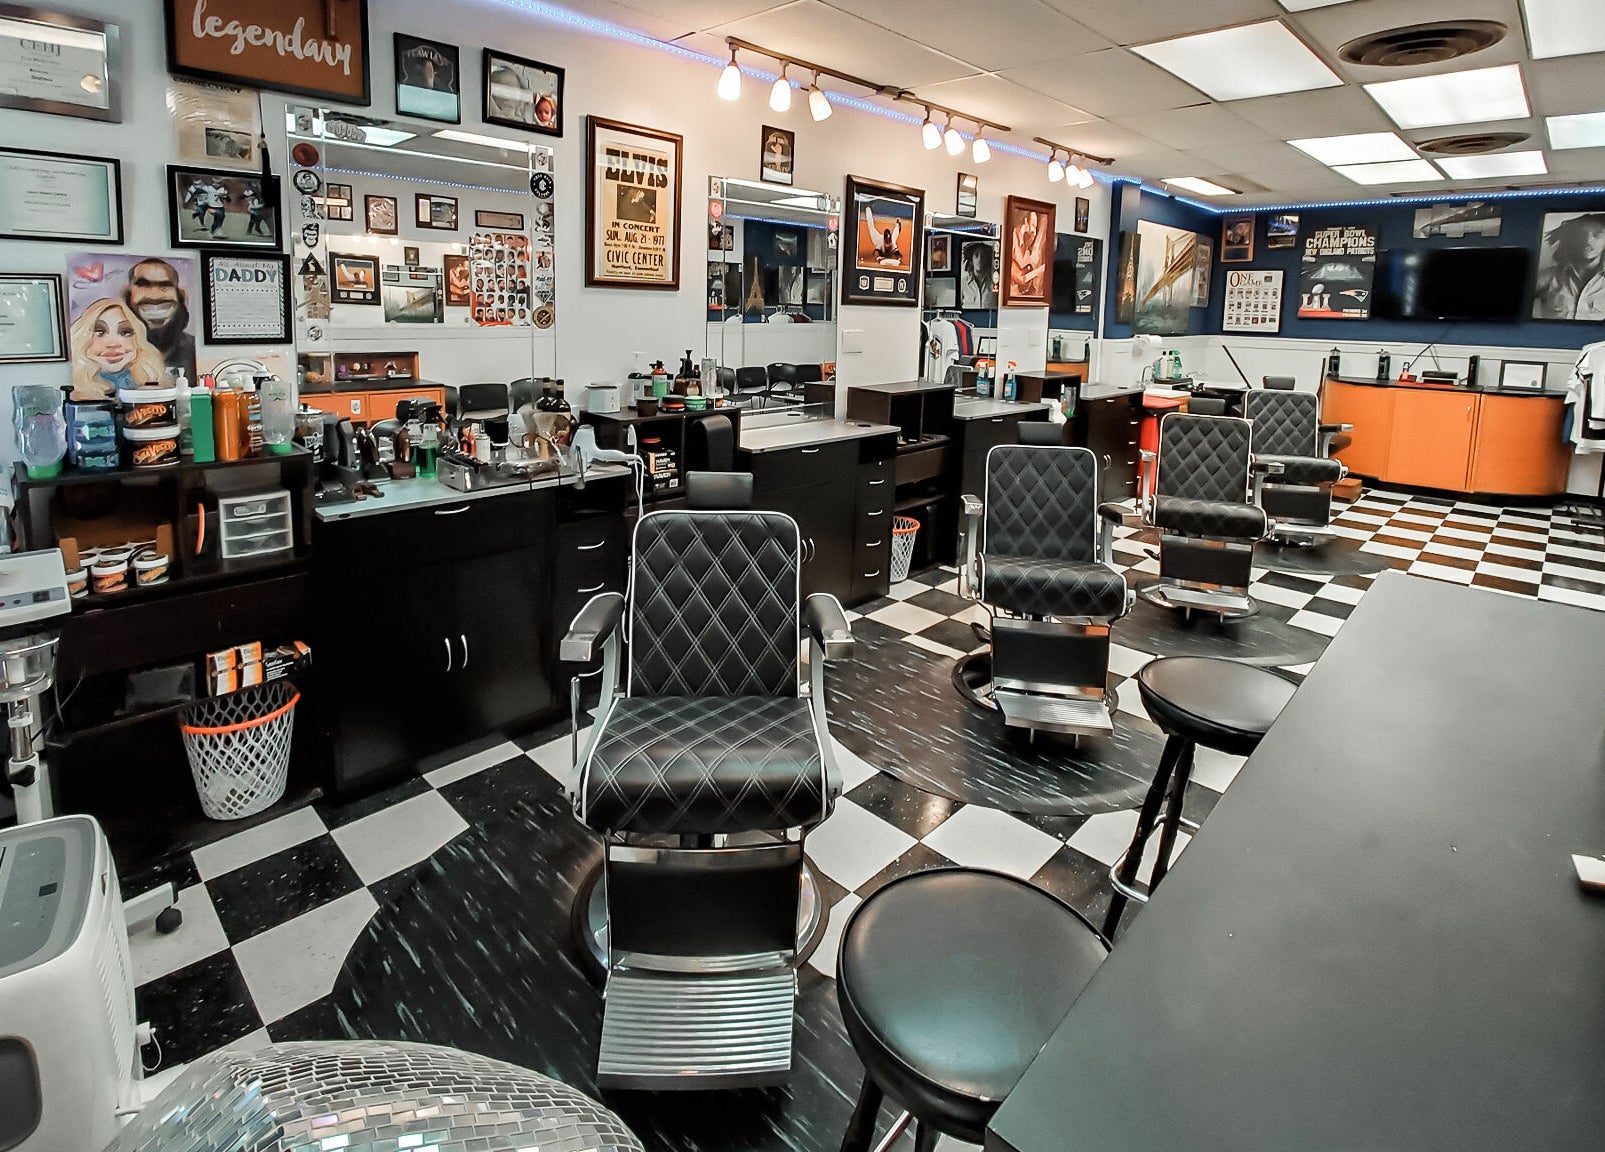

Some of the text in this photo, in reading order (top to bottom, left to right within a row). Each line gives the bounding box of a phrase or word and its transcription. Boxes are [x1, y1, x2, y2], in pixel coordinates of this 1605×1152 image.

[192, 0, 352, 76] legendary
[605, 147, 668, 188] ELVIS
[622, 222, 660, 234] CONCERT
[1315, 229, 1367, 239] SUPER BOWL
[1306, 236, 1375, 249] CHAMPIONS
[606, 249, 664, 267] CIVIC CENTER
[214, 267, 278, 284] DADDY
